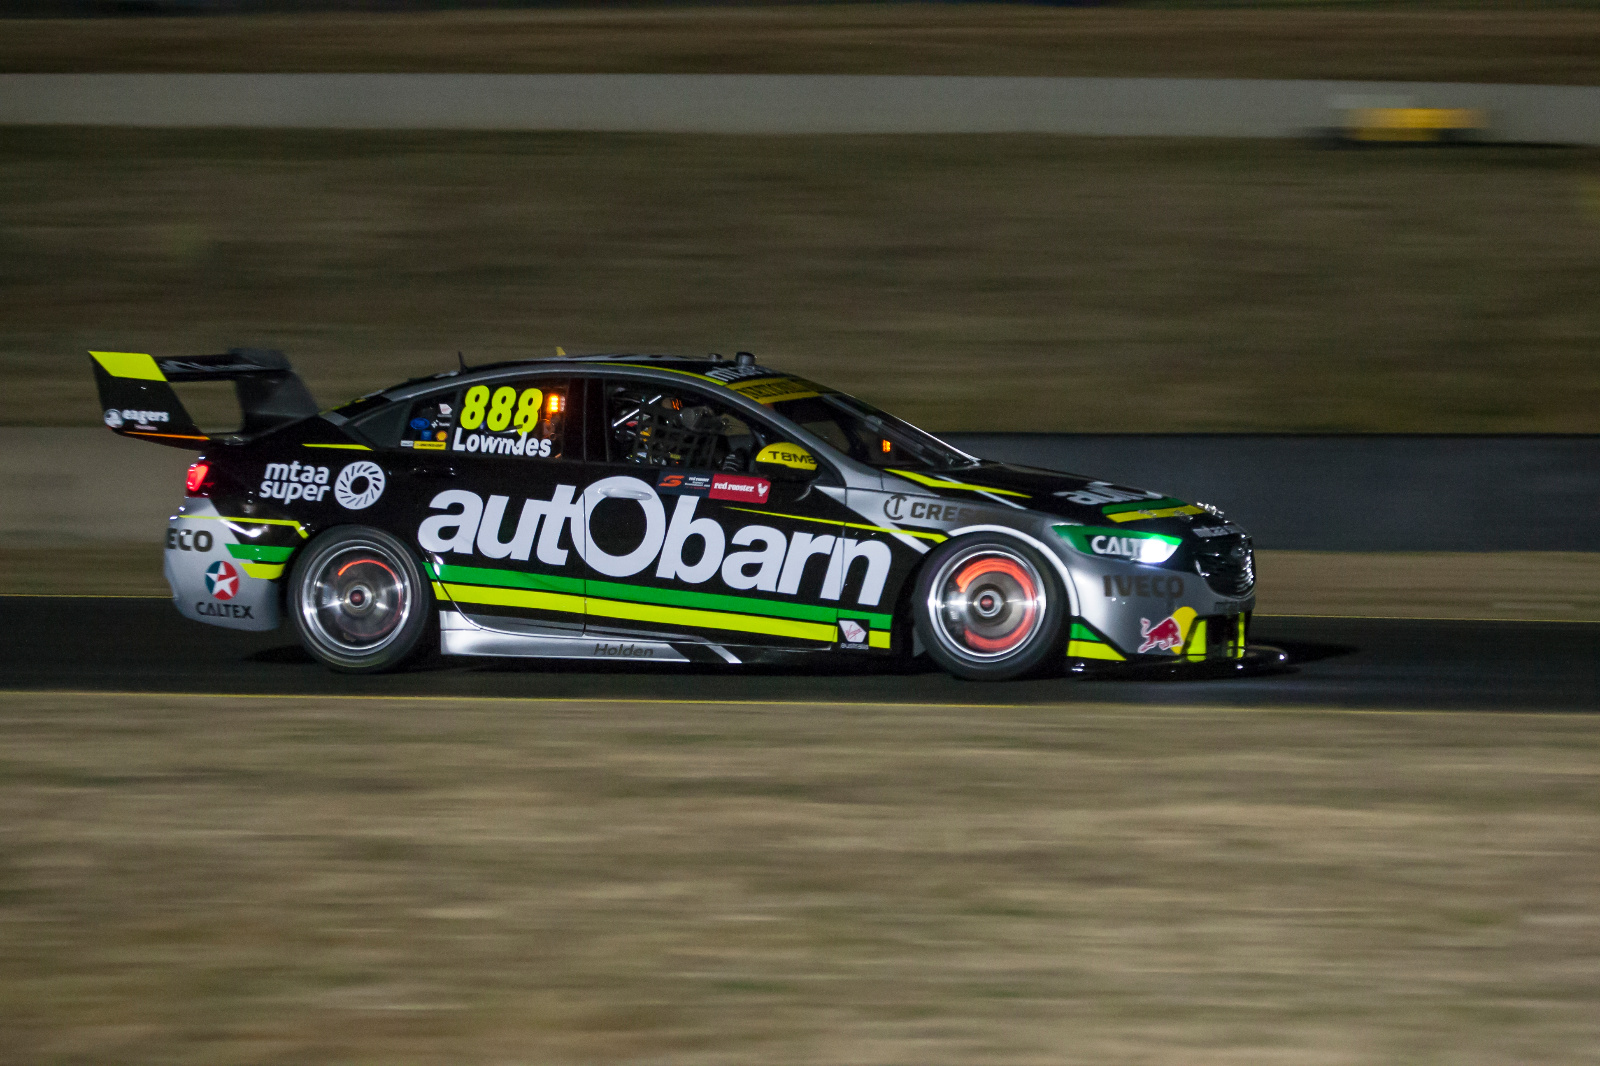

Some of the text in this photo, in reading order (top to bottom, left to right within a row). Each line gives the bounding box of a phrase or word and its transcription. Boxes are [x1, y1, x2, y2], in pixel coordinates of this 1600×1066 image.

[460, 385, 543, 436] 888
[452, 427, 552, 457] Lowndes
[264, 460, 329, 484] mtaa
[259, 480, 331, 504] super
[714, 481, 728, 490] red
[728, 483, 755, 492] rooster
[1103, 575, 1184, 599] IVECO
[196, 601, 254, 620] CALTEX
[593, 643, 654, 658] Holden
